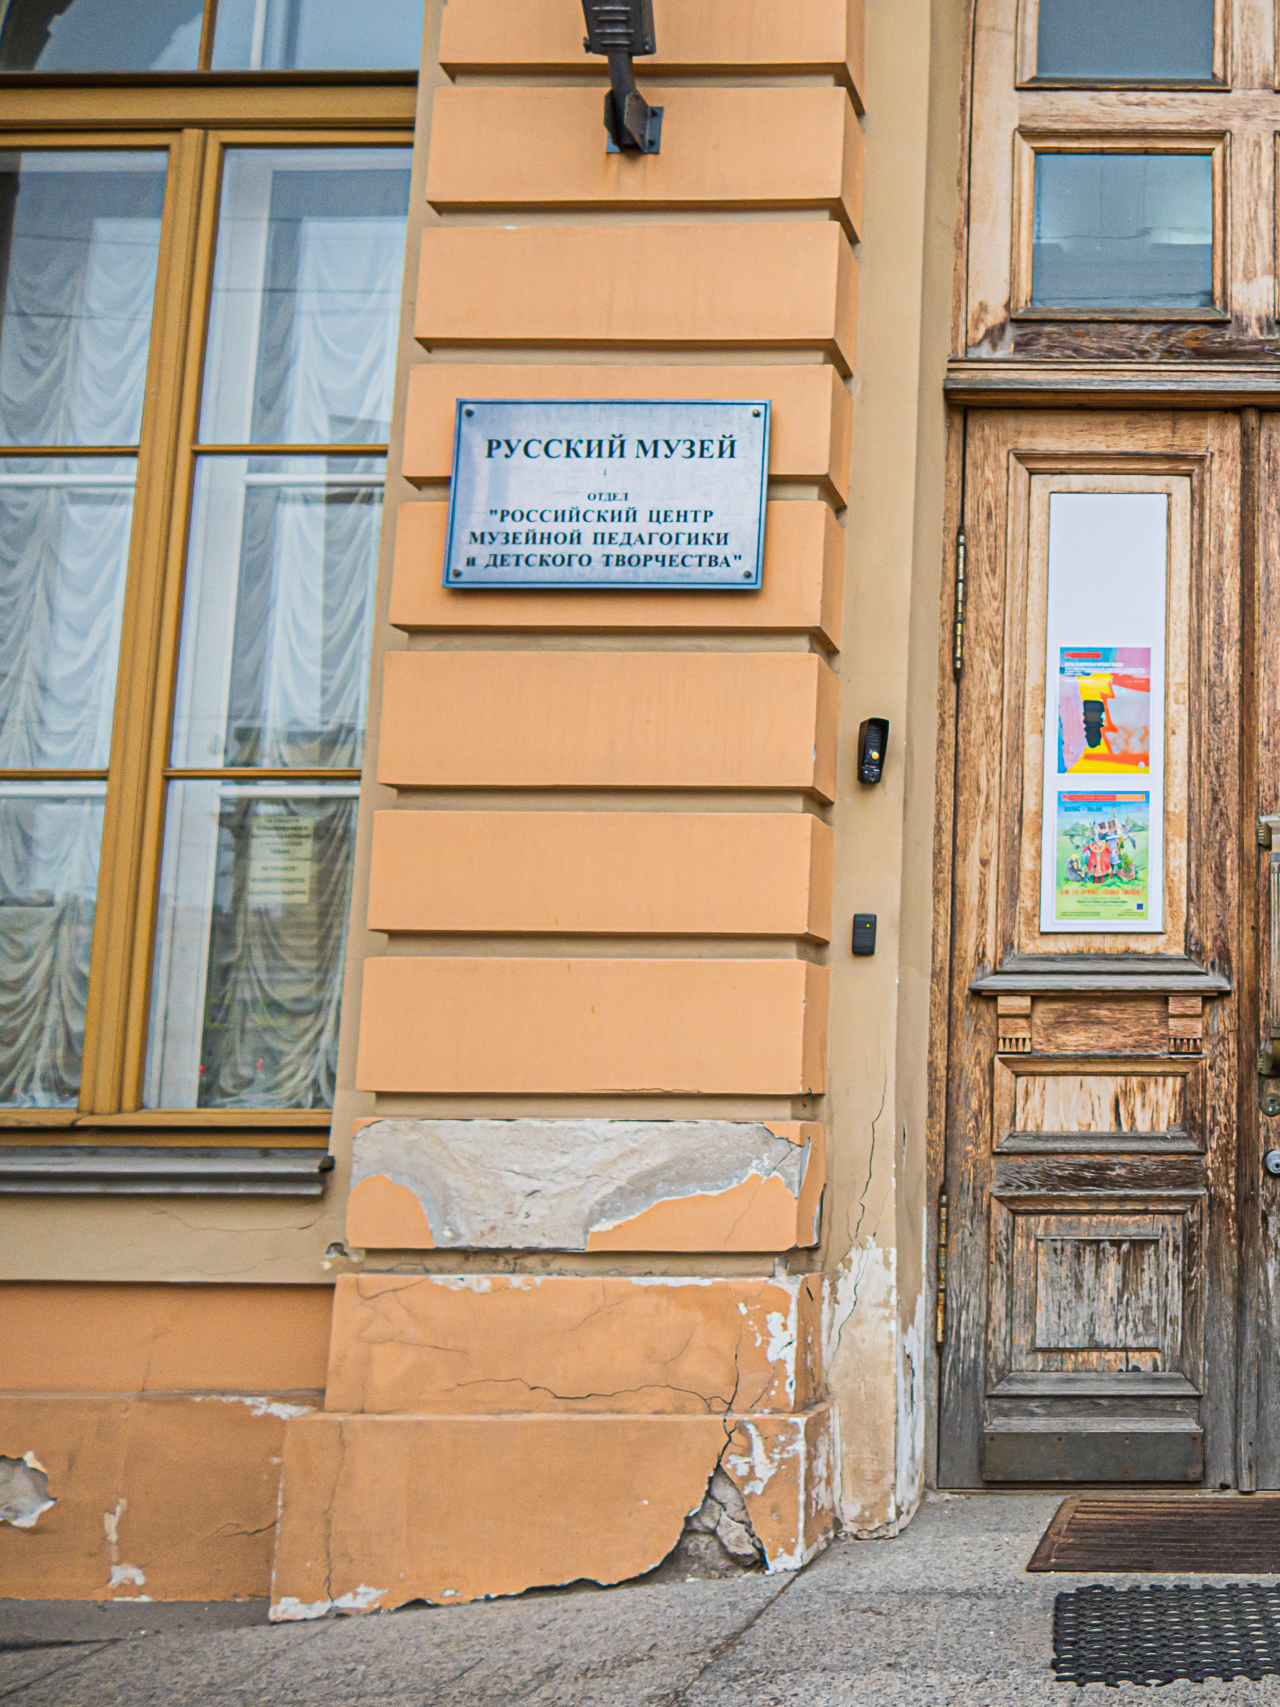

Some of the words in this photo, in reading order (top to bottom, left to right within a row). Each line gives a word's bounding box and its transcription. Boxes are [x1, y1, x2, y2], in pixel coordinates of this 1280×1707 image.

[485, 434, 626, 459] РУССКИЙ
[635, 435, 738, 459] МУЗЕЙ
[587, 492, 629, 502] ОТДЕЛ
[489, 507, 638, 523] "РОССИЙСКИЙ
[648, 509, 713, 525] ЦЕНТР
[468, 530, 582, 545] МУЗЕЙНОЙ
[592, 532, 729, 546] ПЕДАГОГИКИ
[484, 553, 592, 569] ДЕТСКОГО
[602, 553, 743, 568] ТВОРЧЕСТВА"
